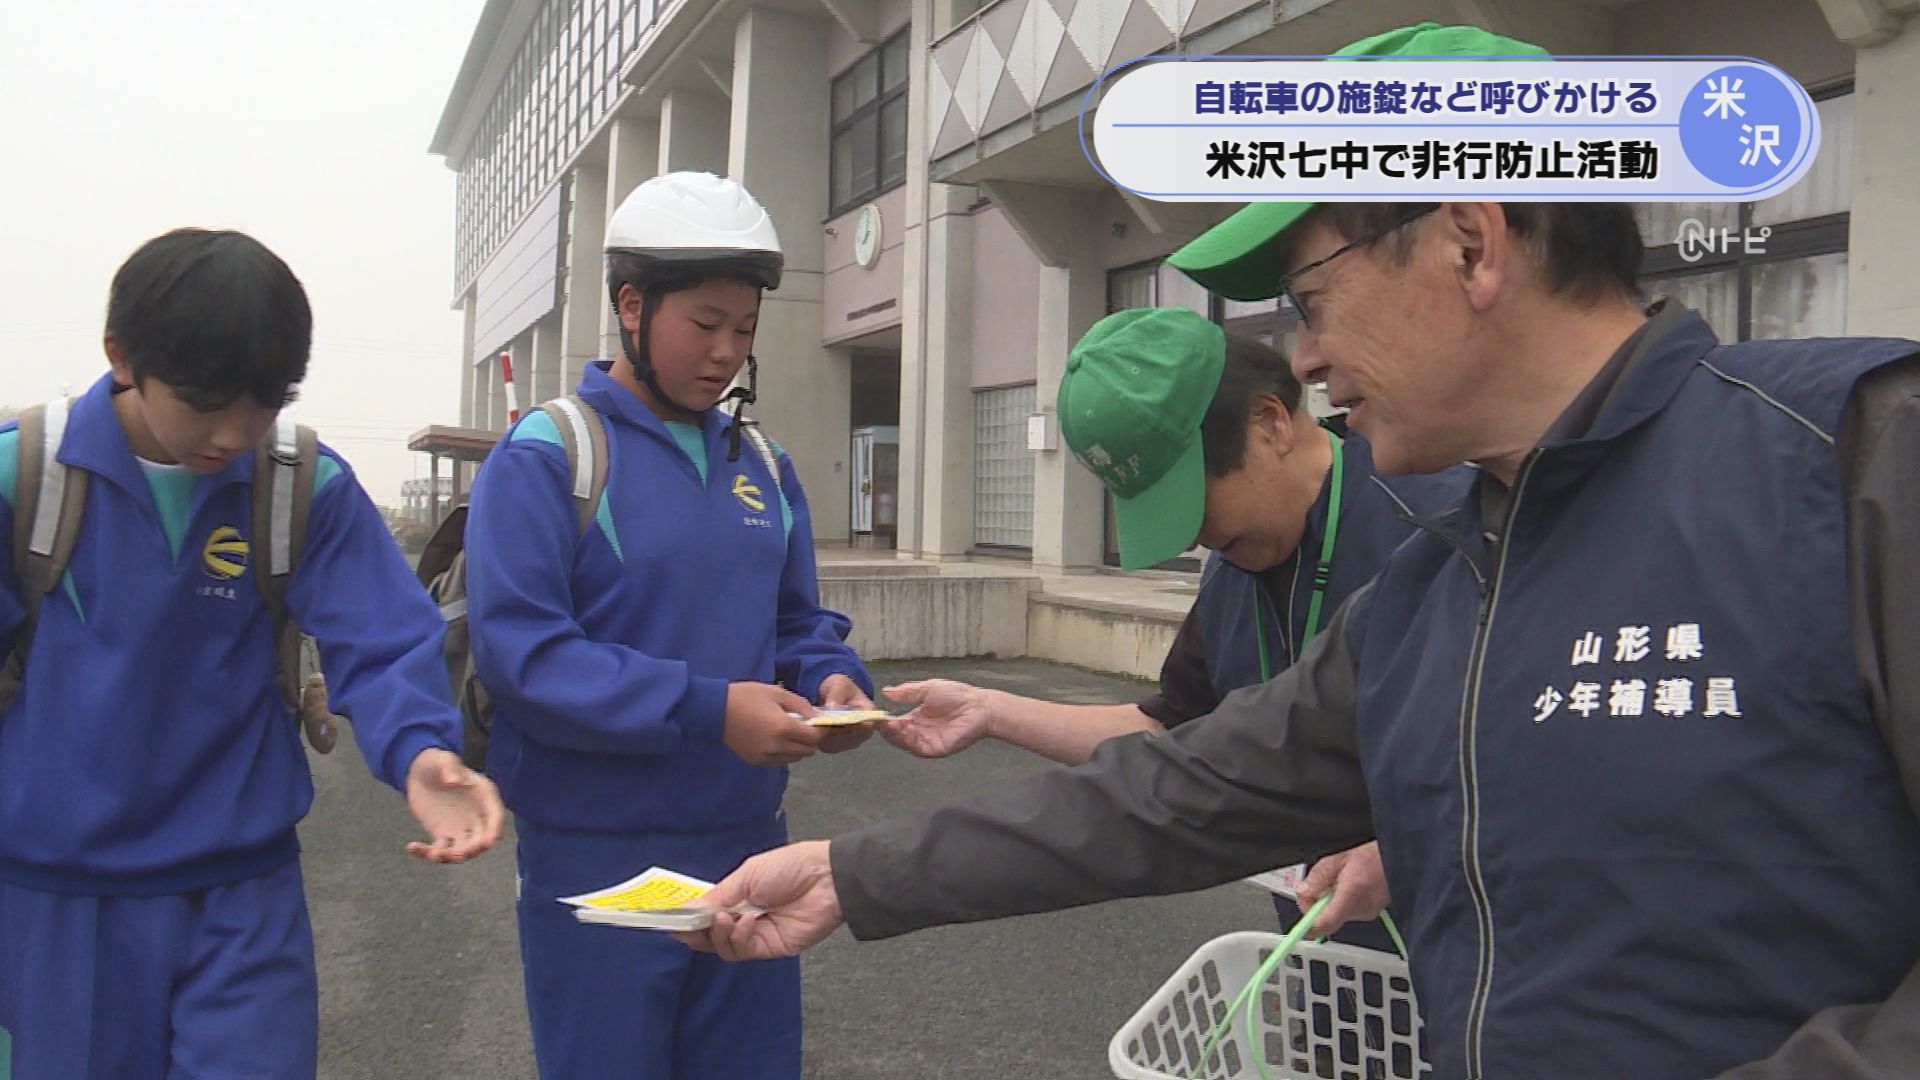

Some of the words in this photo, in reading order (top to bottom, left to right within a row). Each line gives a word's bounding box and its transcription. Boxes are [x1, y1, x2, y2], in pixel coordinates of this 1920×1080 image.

[1571, 622, 1704, 666] 山形県
[1533, 676, 1743, 723] 少年補導員
